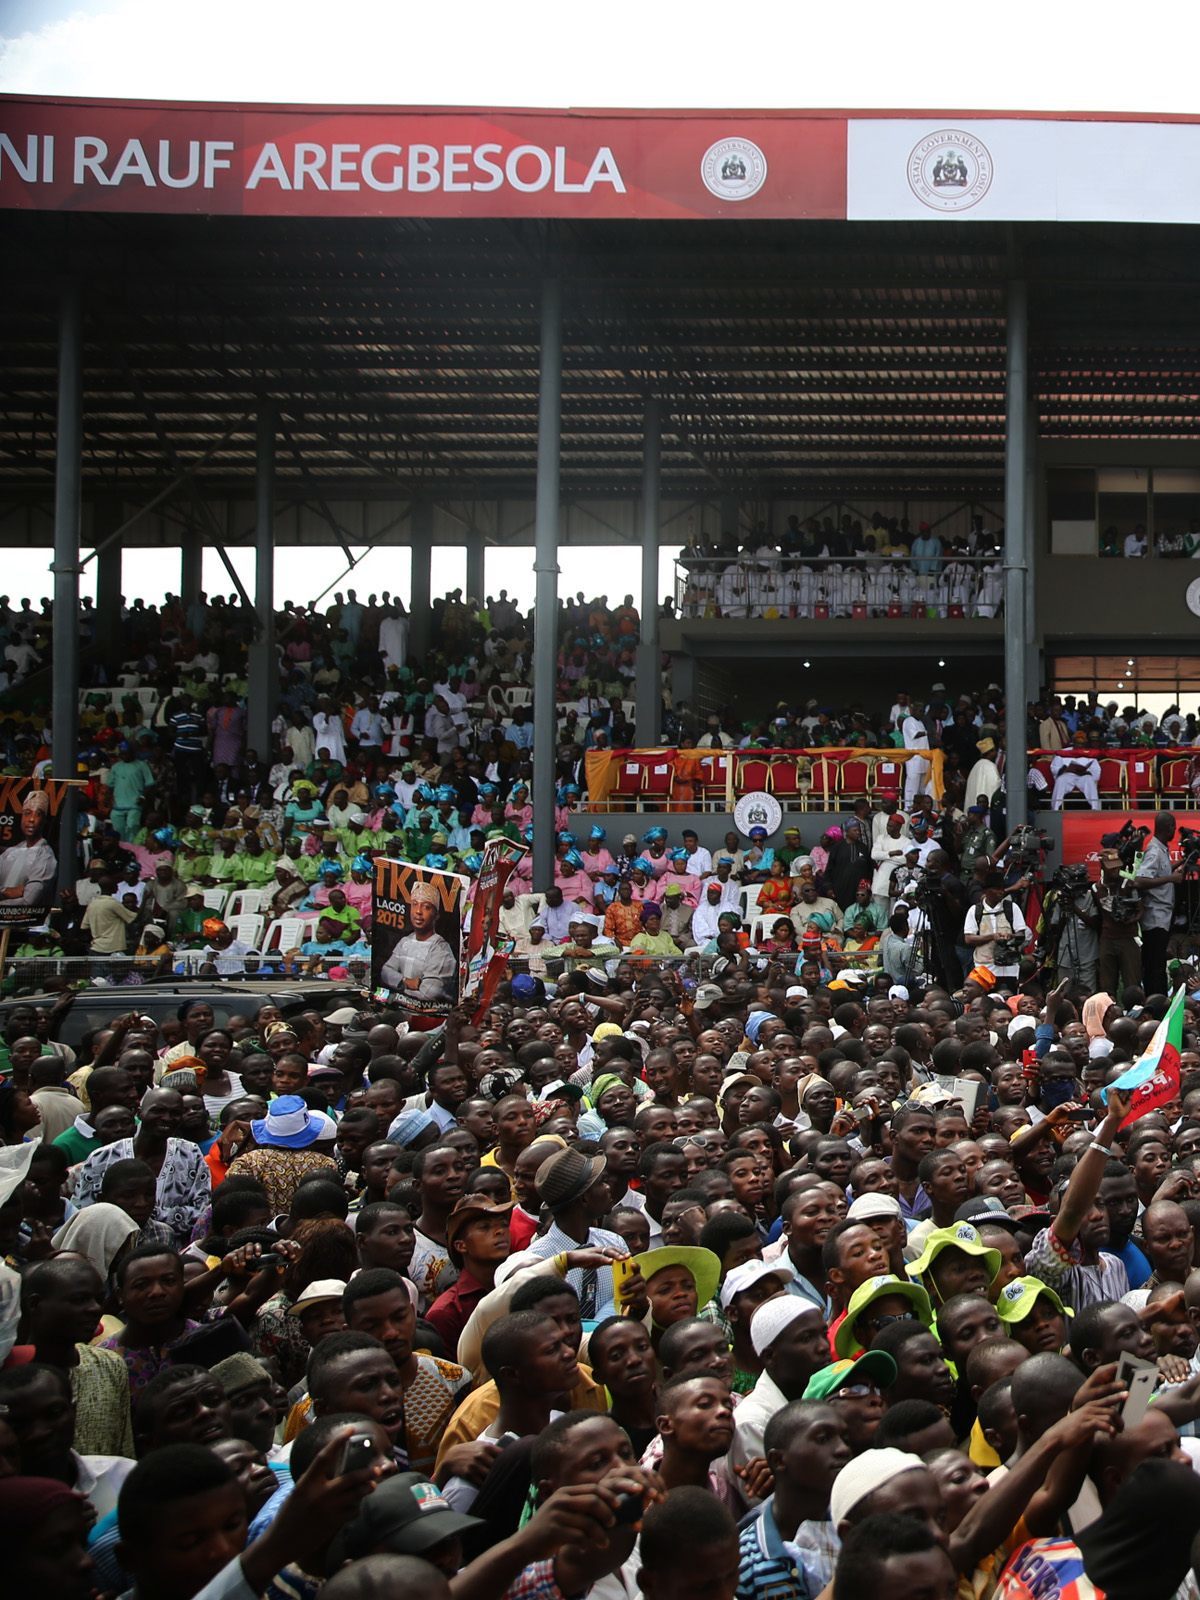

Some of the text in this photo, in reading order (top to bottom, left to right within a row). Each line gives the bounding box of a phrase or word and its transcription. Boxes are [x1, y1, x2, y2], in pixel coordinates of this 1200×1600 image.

[74, 136, 235, 189] RAUF
[245, 142, 627, 193] AREGBESOLA
[913, 155, 922, 184] STATE
[921, 134, 984, 159] GOVERNMENT
[970, 173, 988, 199] OSUN
[376, 898, 406, 915] LAGOS
[376, 909, 405, 929] 2015
